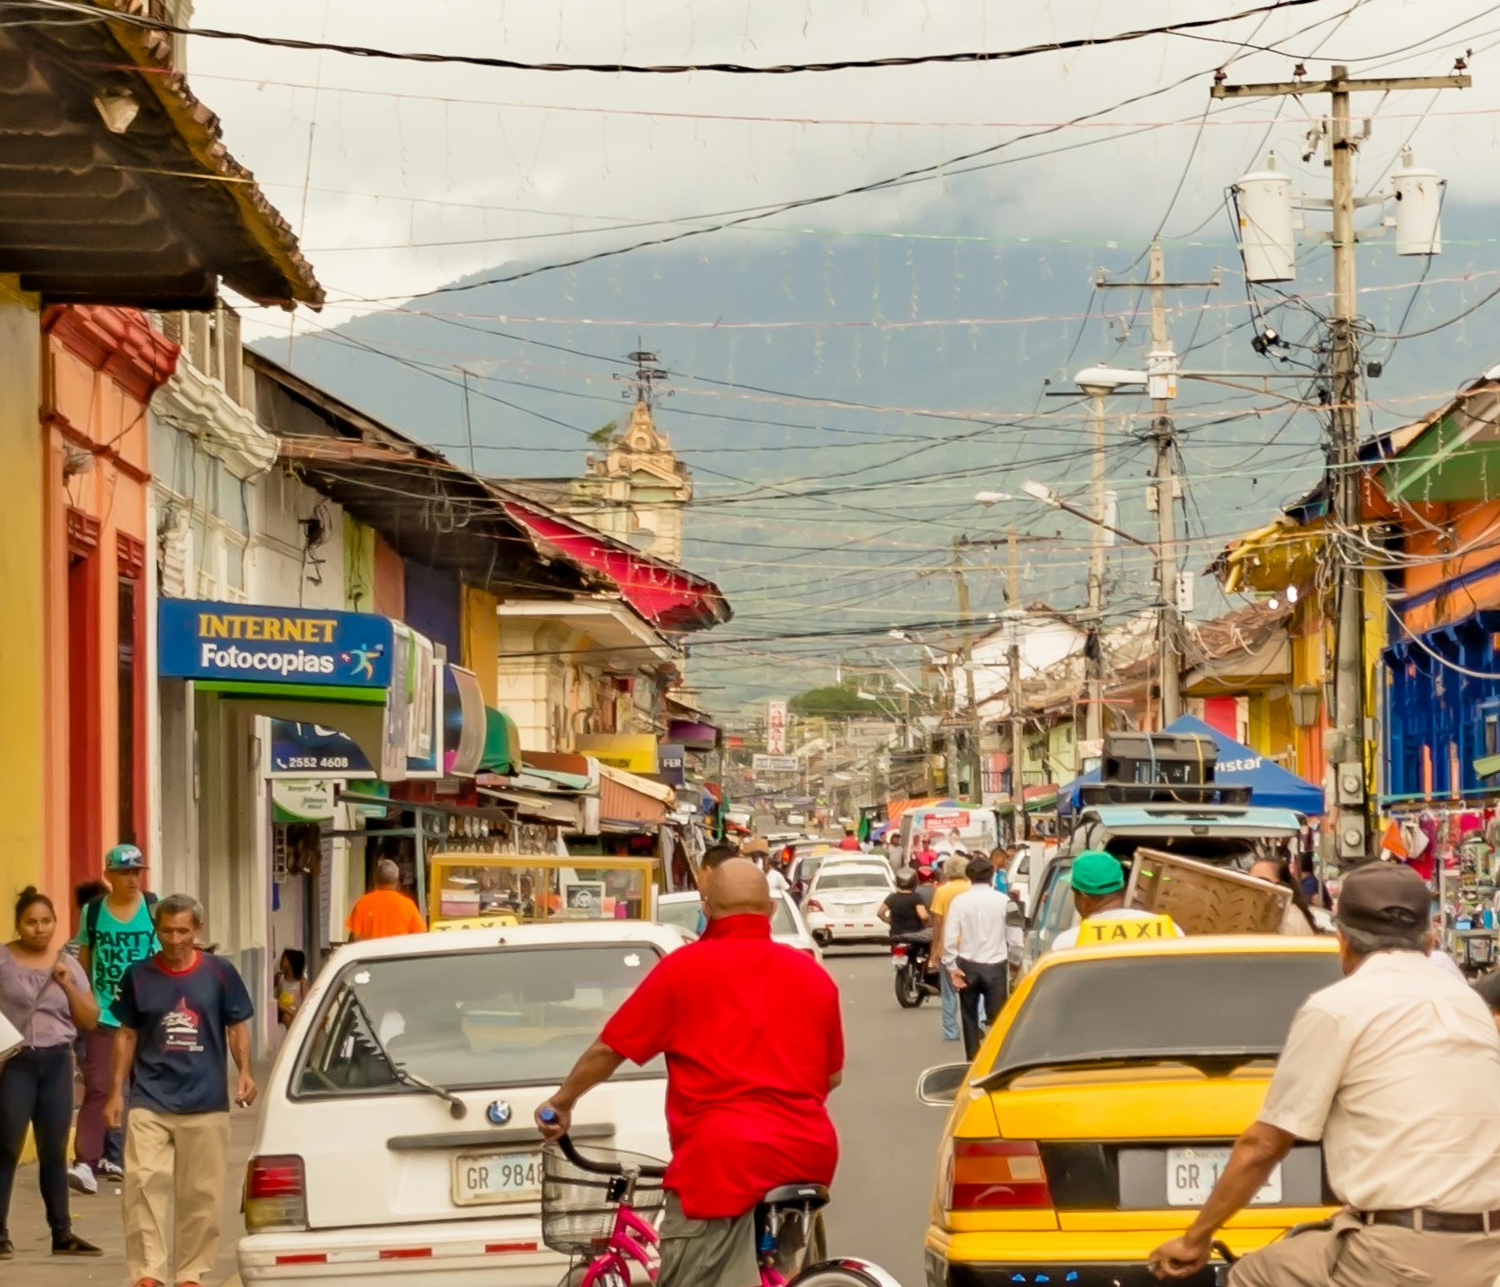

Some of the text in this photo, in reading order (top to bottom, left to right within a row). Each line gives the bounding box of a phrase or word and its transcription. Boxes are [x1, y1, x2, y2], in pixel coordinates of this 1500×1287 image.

[198, 613, 338, 643] INTERNET
[201, 643, 335, 676] Fotocopias
[289, 757, 317, 768] 2552
[1091, 922, 1162, 941] TAXI
[467, 1167, 489, 1190] GR
[1176, 1164, 1200, 1189] GR
